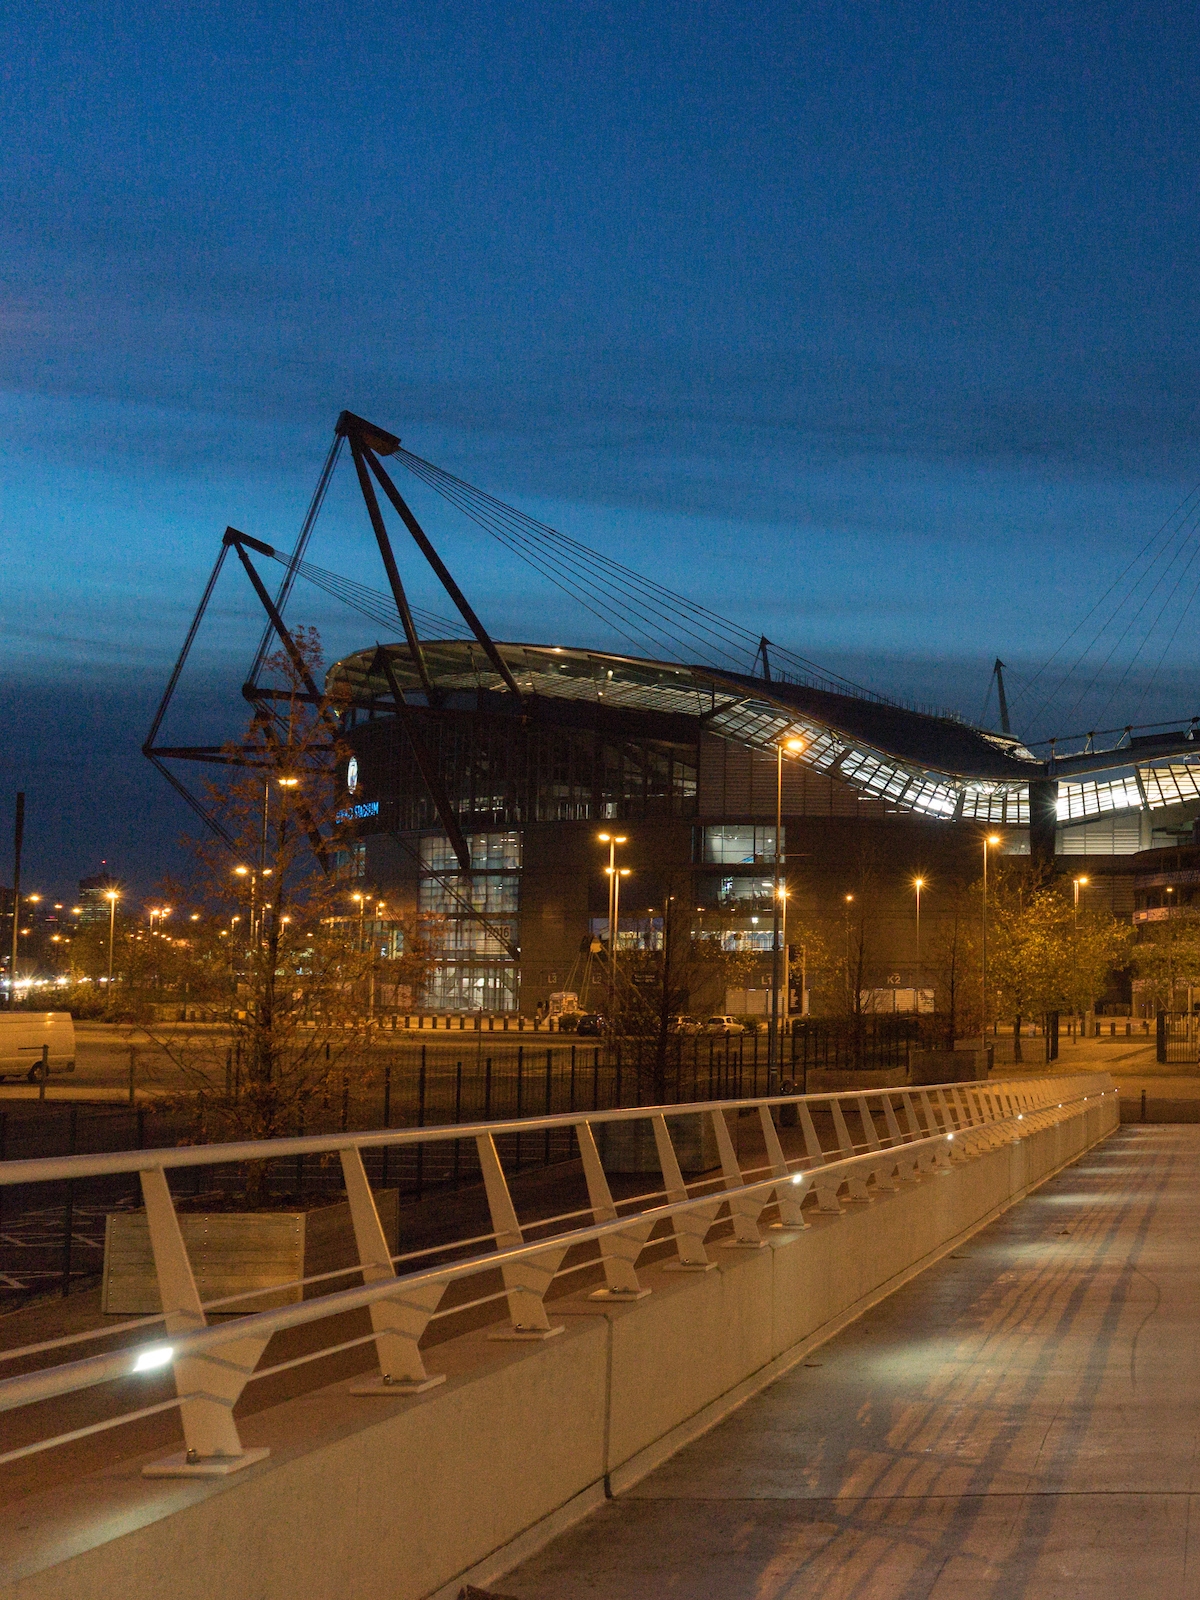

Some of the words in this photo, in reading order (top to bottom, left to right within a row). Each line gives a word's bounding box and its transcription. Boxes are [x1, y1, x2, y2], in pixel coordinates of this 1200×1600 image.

[547, 975, 557, 984] L3
[592, 975, 602, 984] L2
[761, 975, 772, 985] L1
[886, 975, 901, 985] K2
